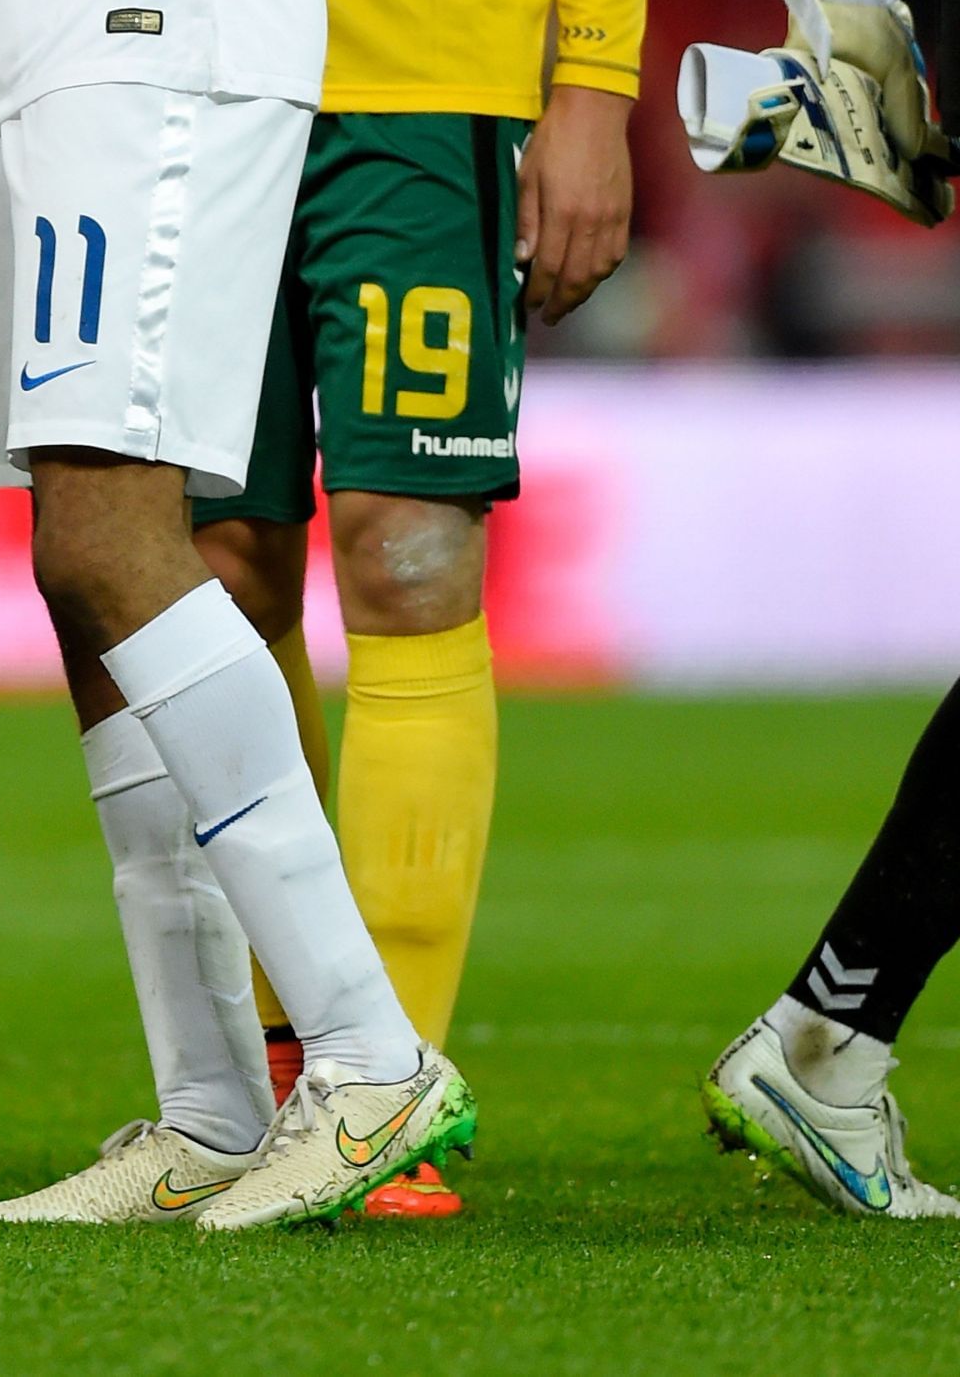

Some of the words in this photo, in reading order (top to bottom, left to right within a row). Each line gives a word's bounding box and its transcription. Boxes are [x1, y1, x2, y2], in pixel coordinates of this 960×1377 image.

[35, 214, 107, 345] 11
[358, 282, 472, 420] 19
[412, 428, 515, 458] hummel
